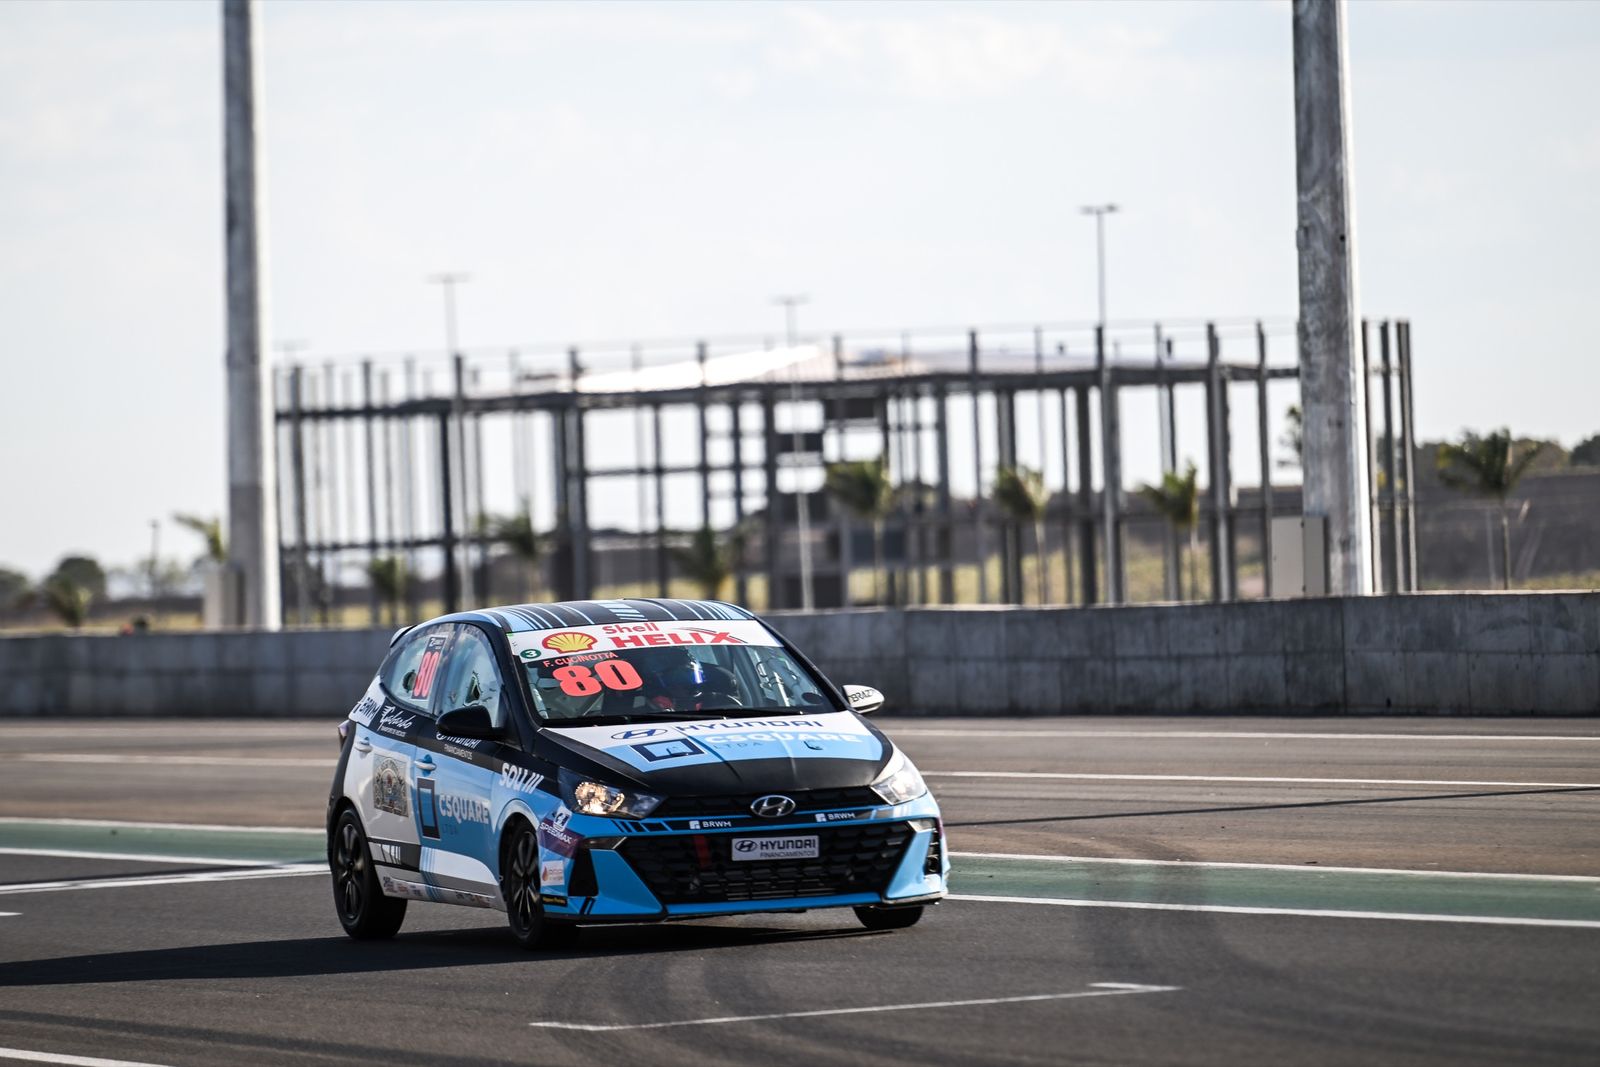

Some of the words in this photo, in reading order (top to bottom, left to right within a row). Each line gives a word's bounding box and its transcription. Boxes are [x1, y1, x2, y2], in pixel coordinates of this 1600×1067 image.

[602, 622, 661, 635] Shell
[608, 632, 743, 649] HELIX
[526, 650, 538, 658] 3
[543, 660, 555, 668] F.
[556, 651, 619, 666] CUCINOTTA
[413, 651, 441, 698] 80
[552, 659, 643, 697] 80
[675, 720, 824, 732] HYUNDAI
[704, 730, 863, 744] CSQUARE
[439, 794, 490, 824] CSQUARE
[827, 812, 856, 821] BRWM
[702, 820, 732, 828] BRWM
[540, 822, 573, 844] SPEEDMAX
[760, 839, 816, 851] HYUNDAI
[760, 850, 816, 858] FINANCIAMENTOS
